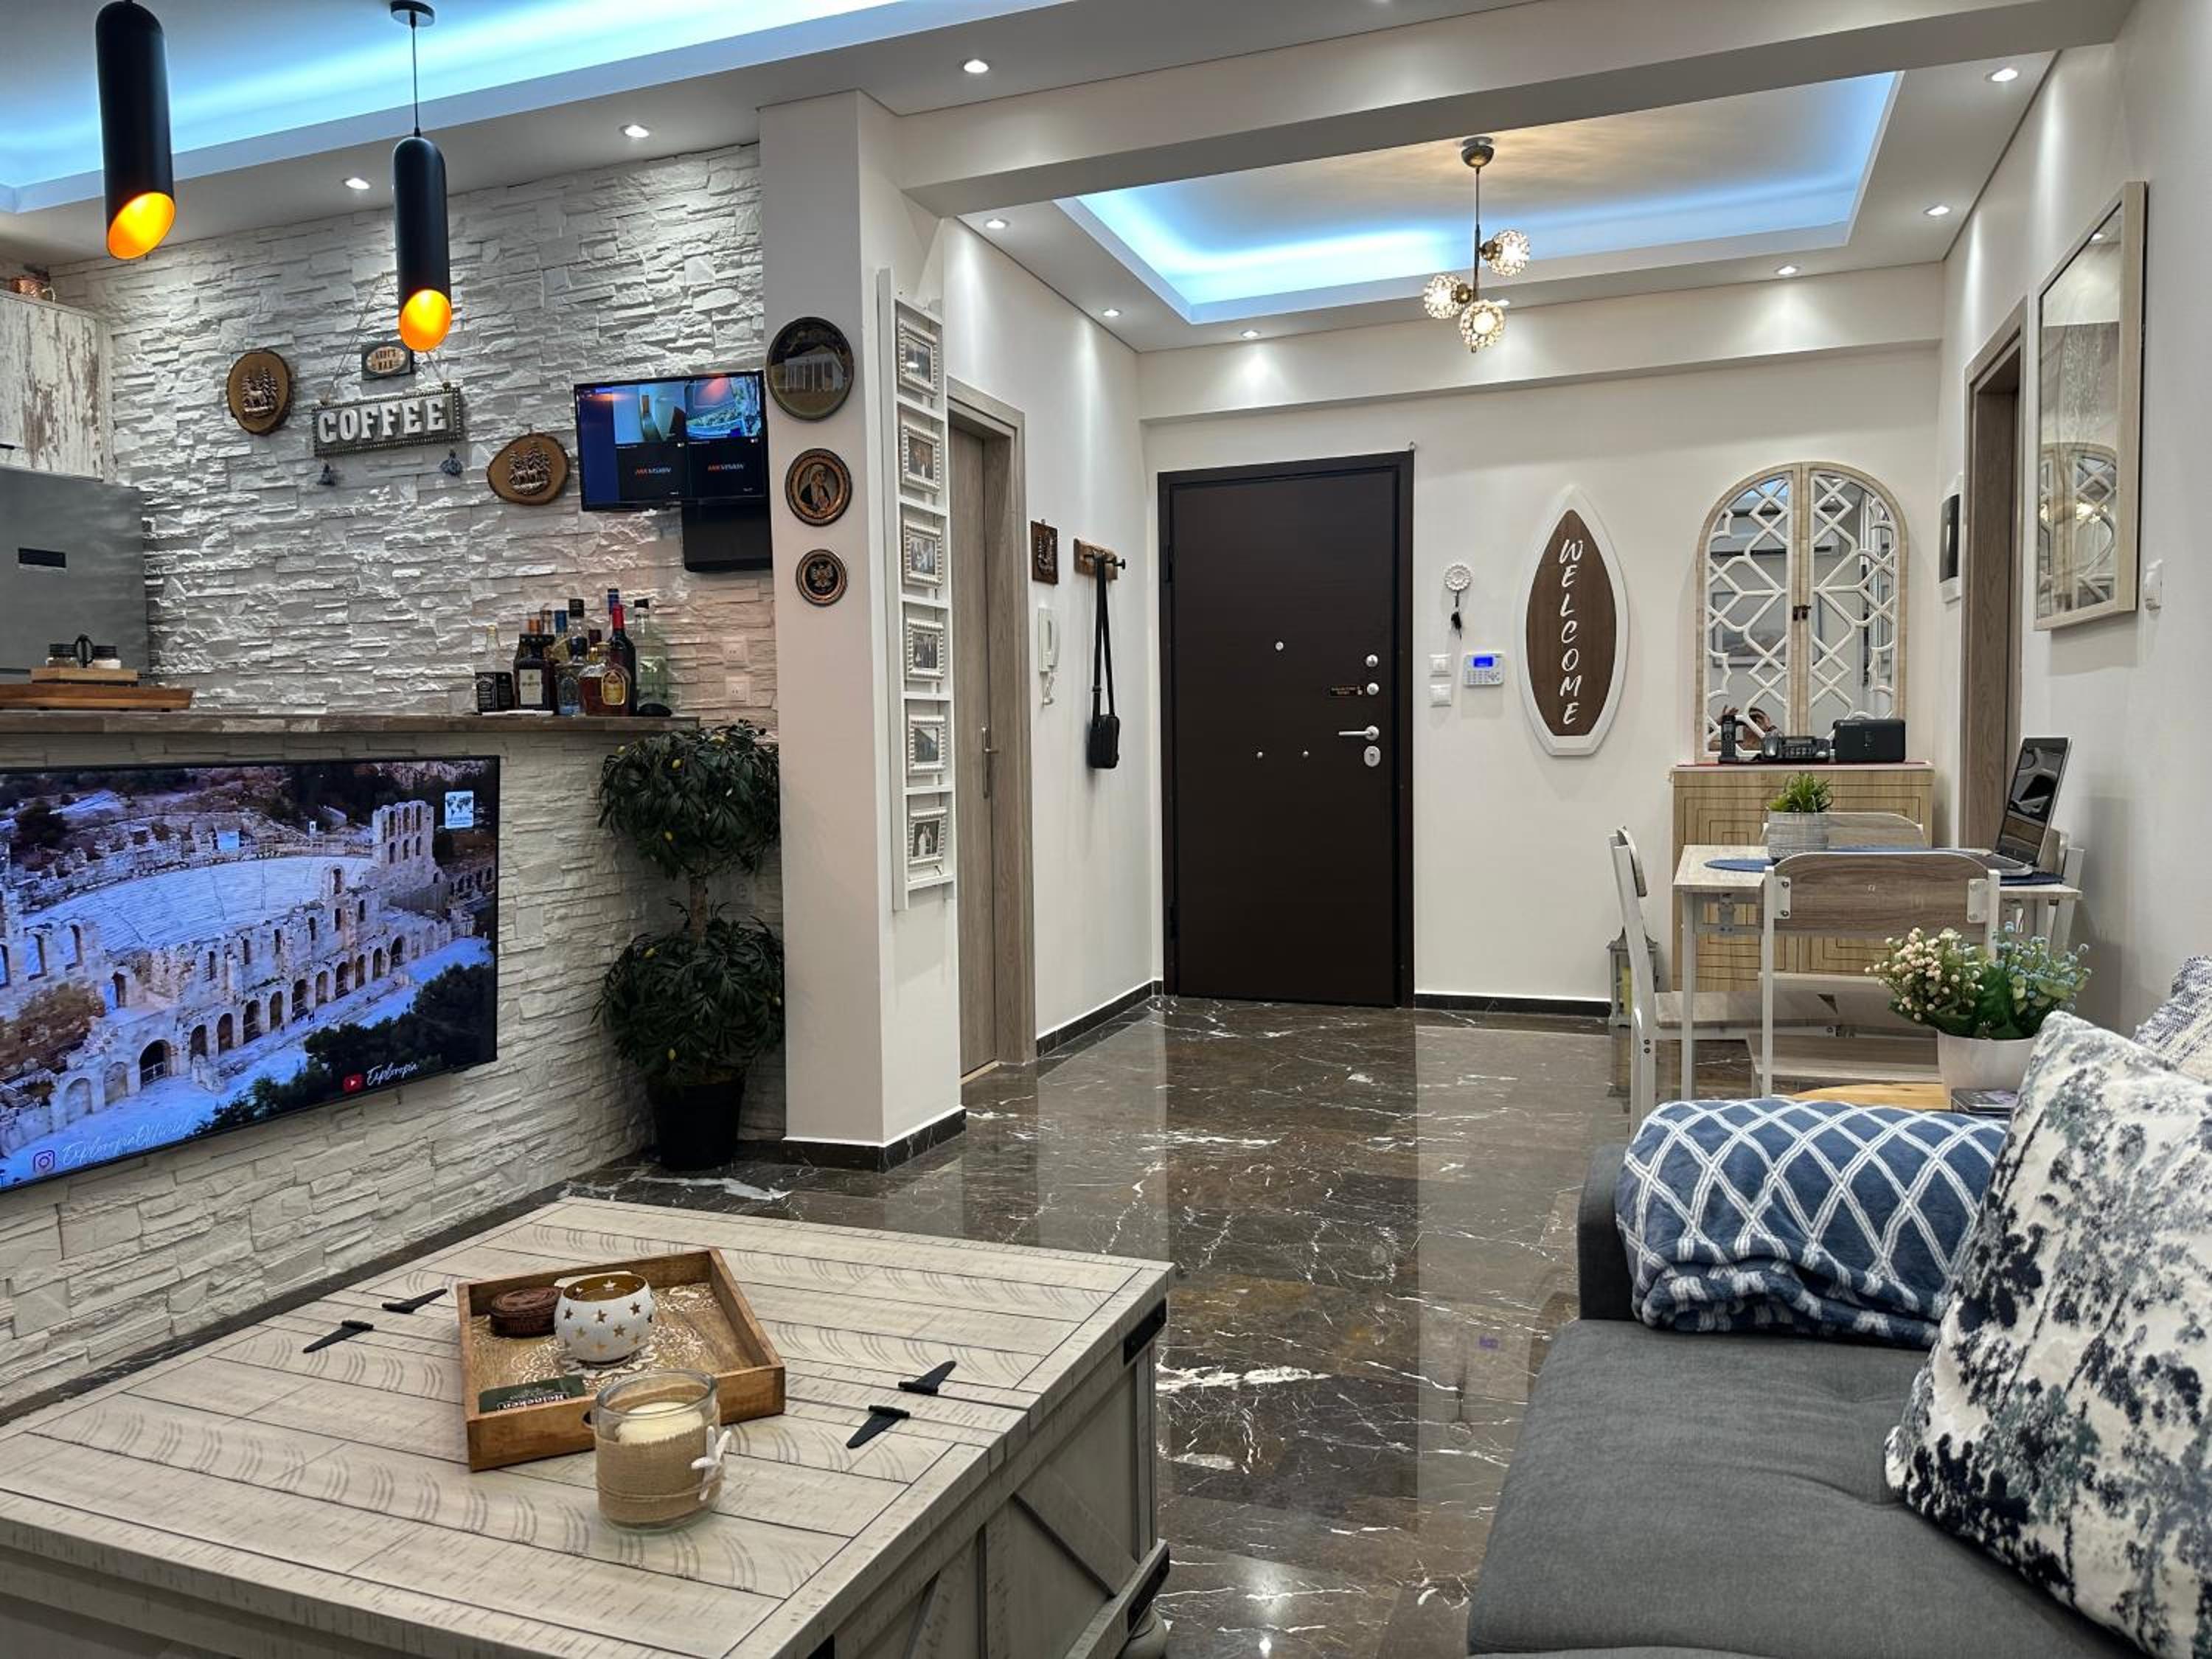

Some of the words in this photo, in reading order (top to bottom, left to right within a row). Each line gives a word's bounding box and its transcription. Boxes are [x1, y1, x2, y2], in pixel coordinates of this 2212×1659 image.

[318, 398, 447, 442] COFFEE
[1558, 539, 1584, 725] WELCOME
[503, 1393, 566, 1409] Heineken
